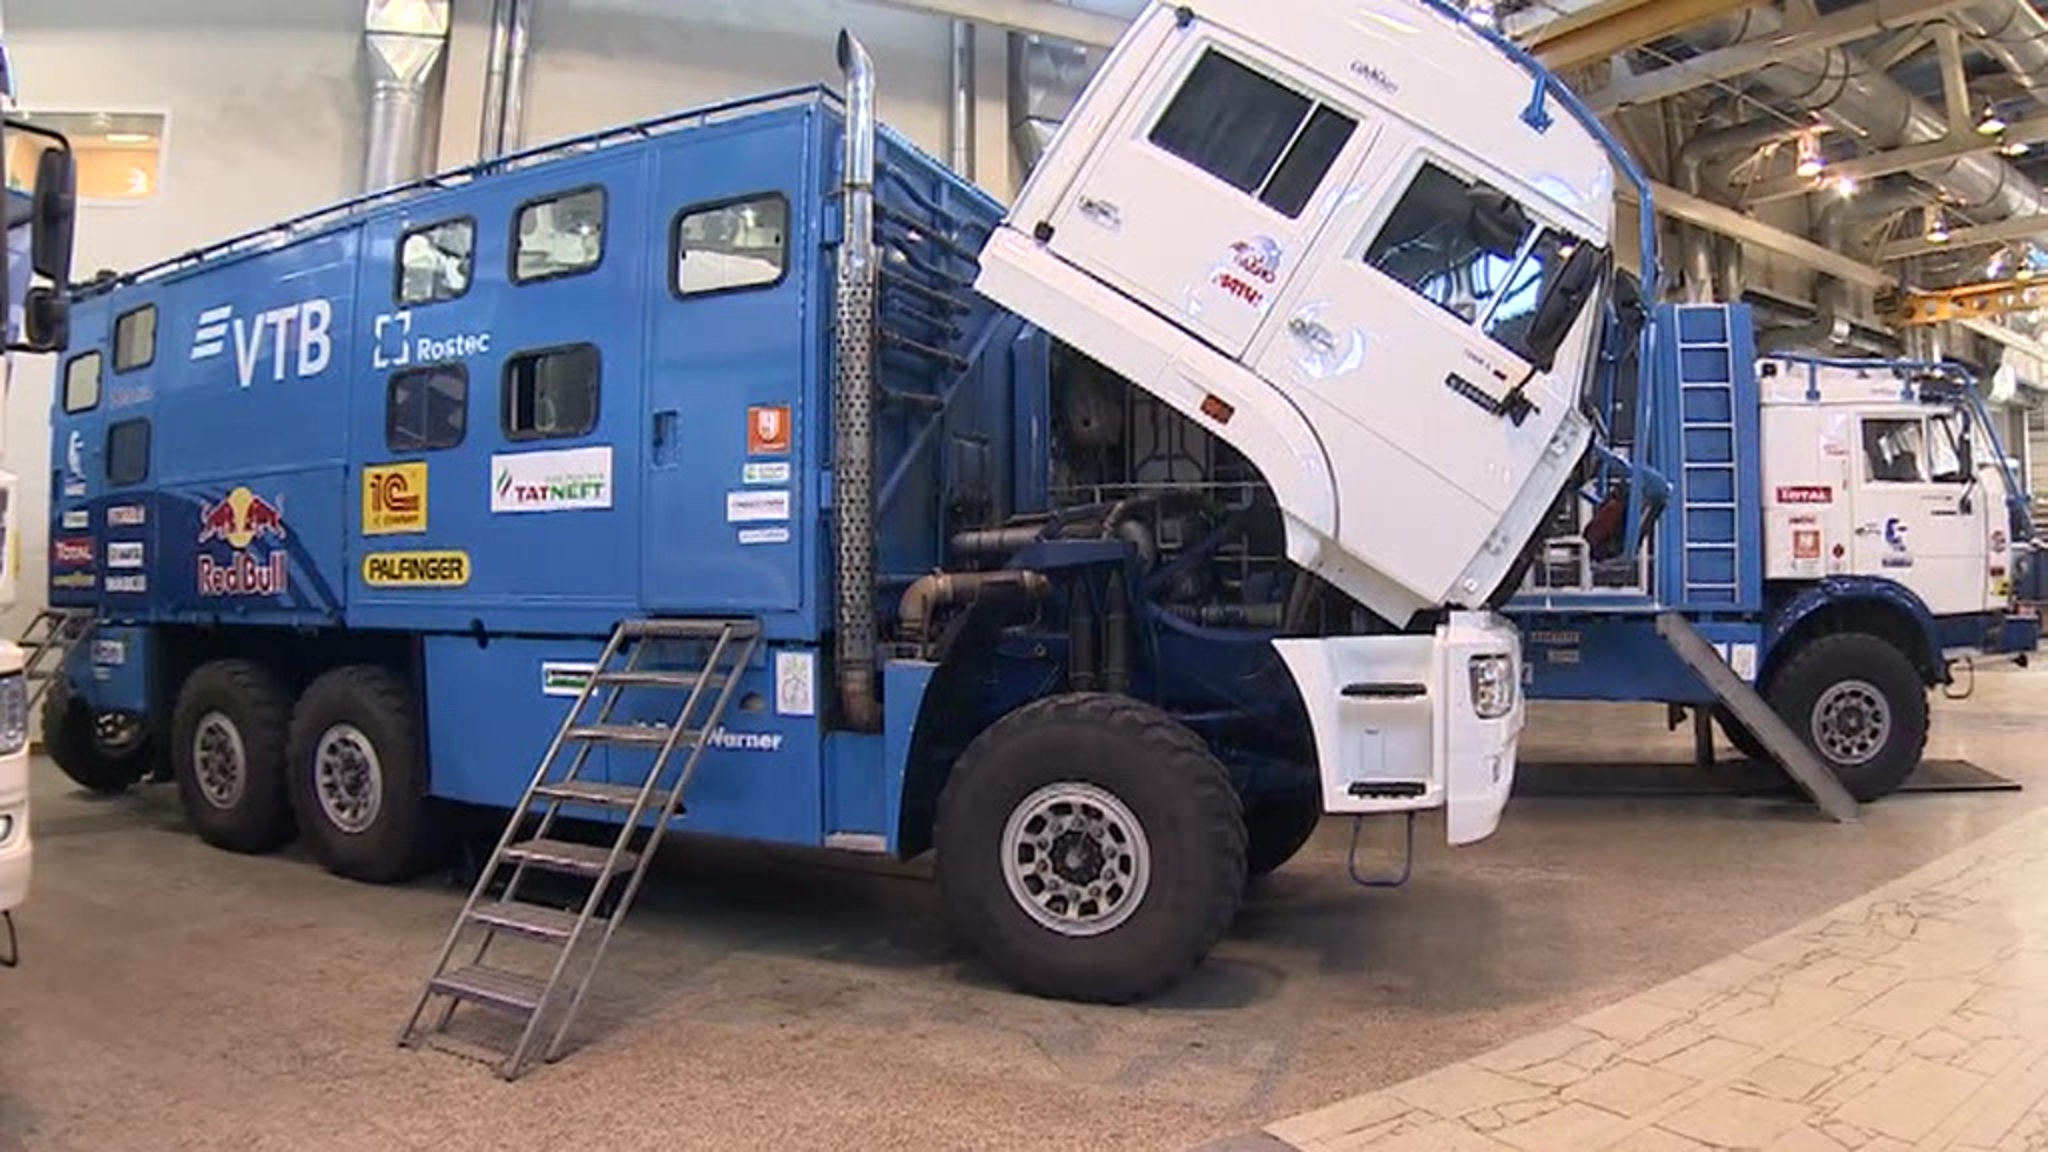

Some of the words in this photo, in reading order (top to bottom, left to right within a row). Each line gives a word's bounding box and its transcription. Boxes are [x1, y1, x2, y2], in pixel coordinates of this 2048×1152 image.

[233, 299, 332, 388] VTB
[417, 333, 490, 361] Rostec
[515, 481, 605, 502] TATNEFT
[198, 551, 243, 596] Red
[243, 550, 288, 595] Bull
[369, 557, 464, 581] PALFINGER
